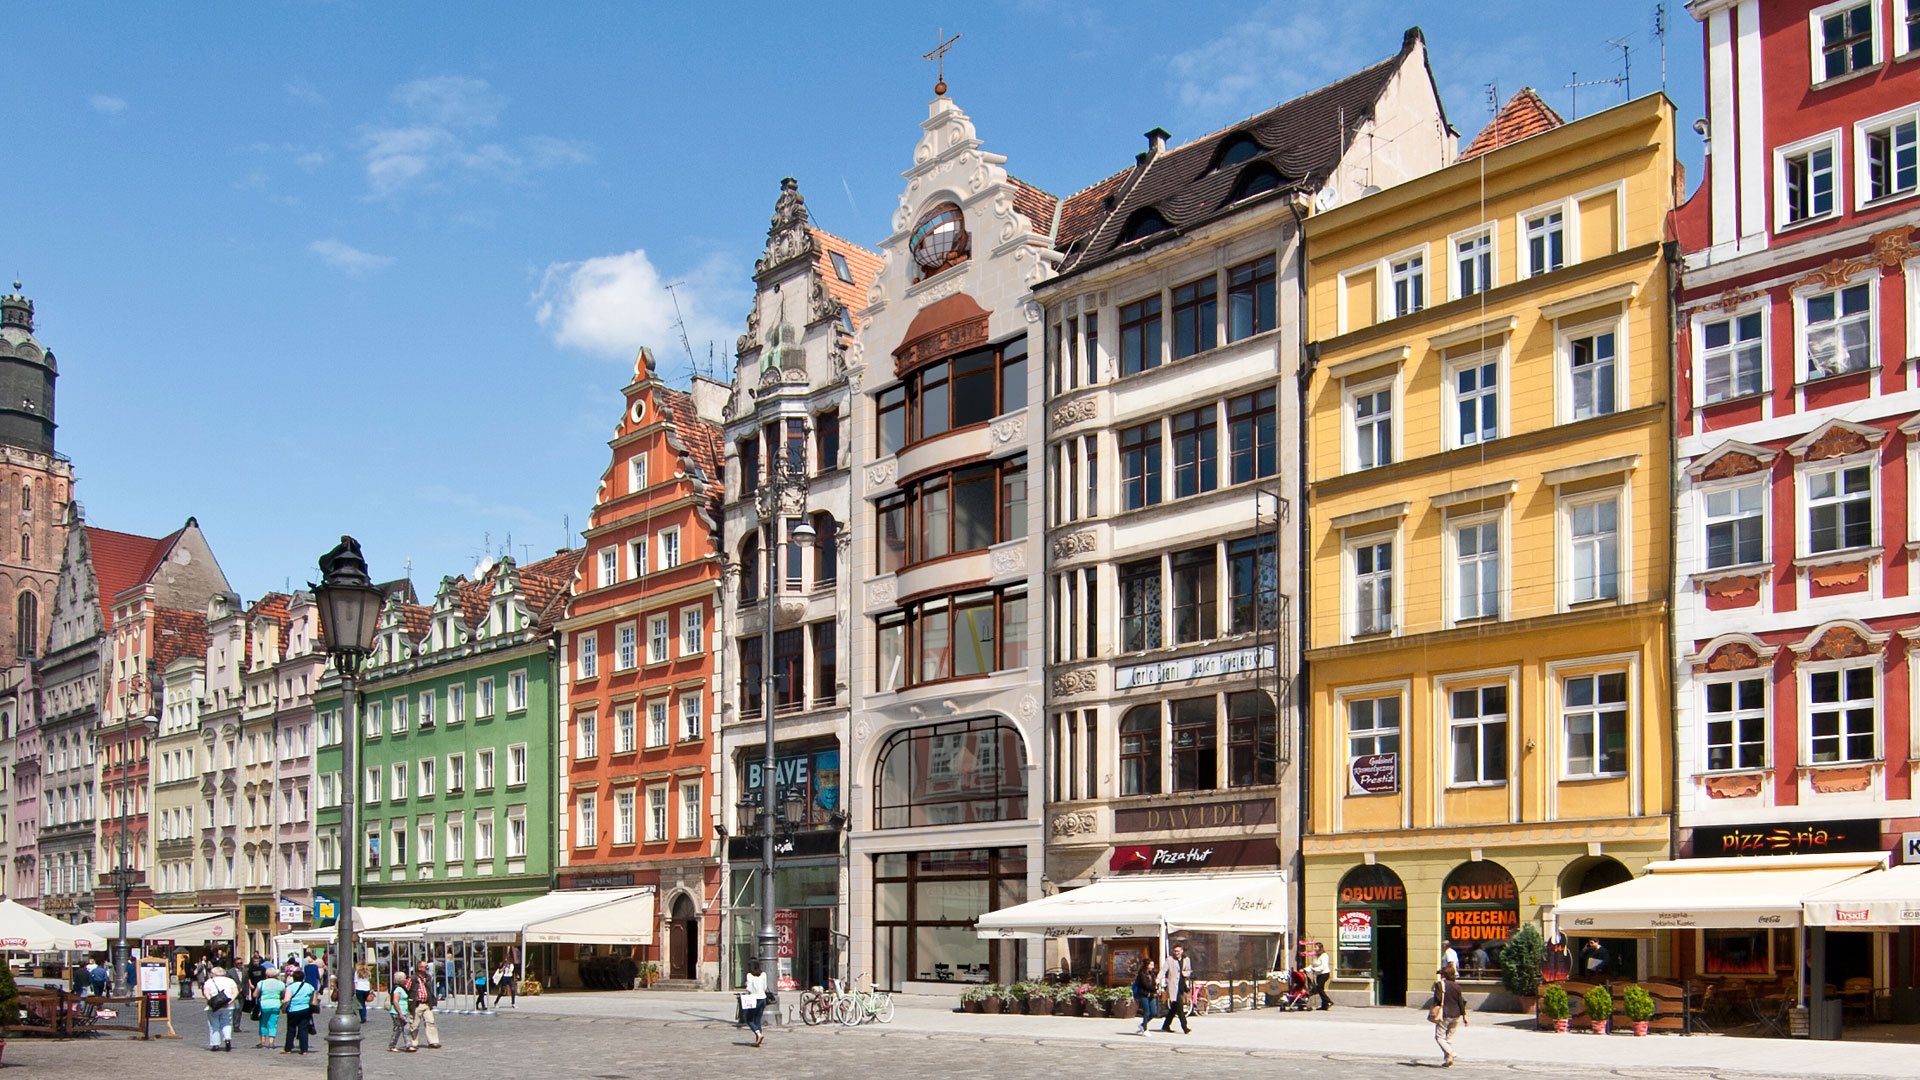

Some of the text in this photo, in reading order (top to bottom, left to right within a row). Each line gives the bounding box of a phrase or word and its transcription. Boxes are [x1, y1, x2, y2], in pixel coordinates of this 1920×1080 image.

[1147, 803, 1244, 829] DAVIDE
[1153, 848, 1213, 865] Pizza Hut
[1343, 885, 1403, 902] OBUWIE
[1447, 884, 1515, 900] OBUWIE
[1232, 896, 1273, 911] Pizza Hut
[1446, 910, 1517, 925] PRZECENA
[1838, 911, 1868, 920] TYSKIE
[1044, 926, 1084, 937] Pizza Hut
[1451, 925, 1511, 940] OBUWIE
